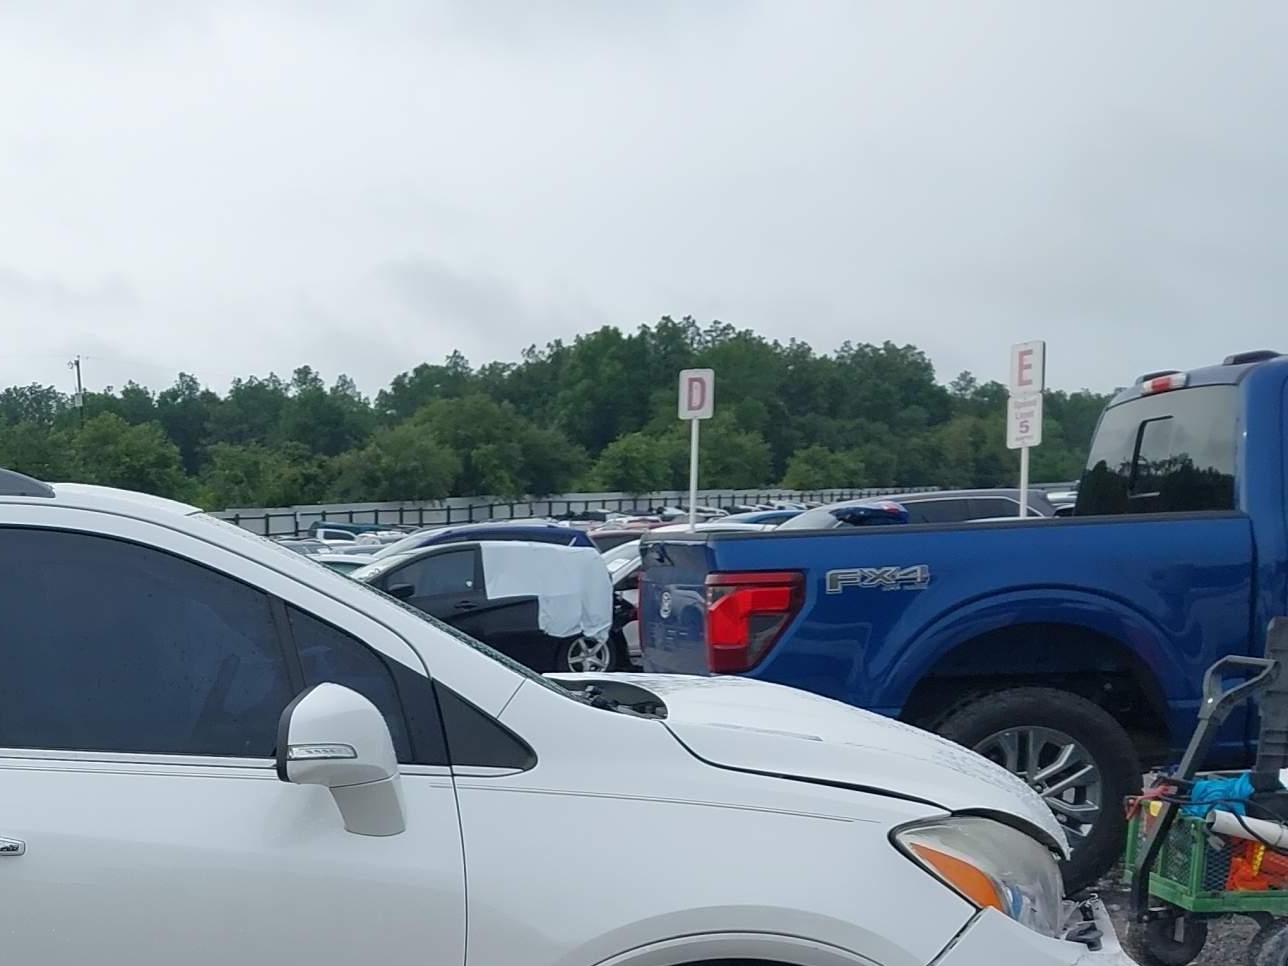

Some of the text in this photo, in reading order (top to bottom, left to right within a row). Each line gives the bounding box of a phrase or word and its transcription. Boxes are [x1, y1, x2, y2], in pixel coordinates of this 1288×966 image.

[1018, 349, 1033, 386] E
[688, 377, 706, 411] D
[1019, 420, 1030, 434] 5
[825, 564, 929, 594] FX4
